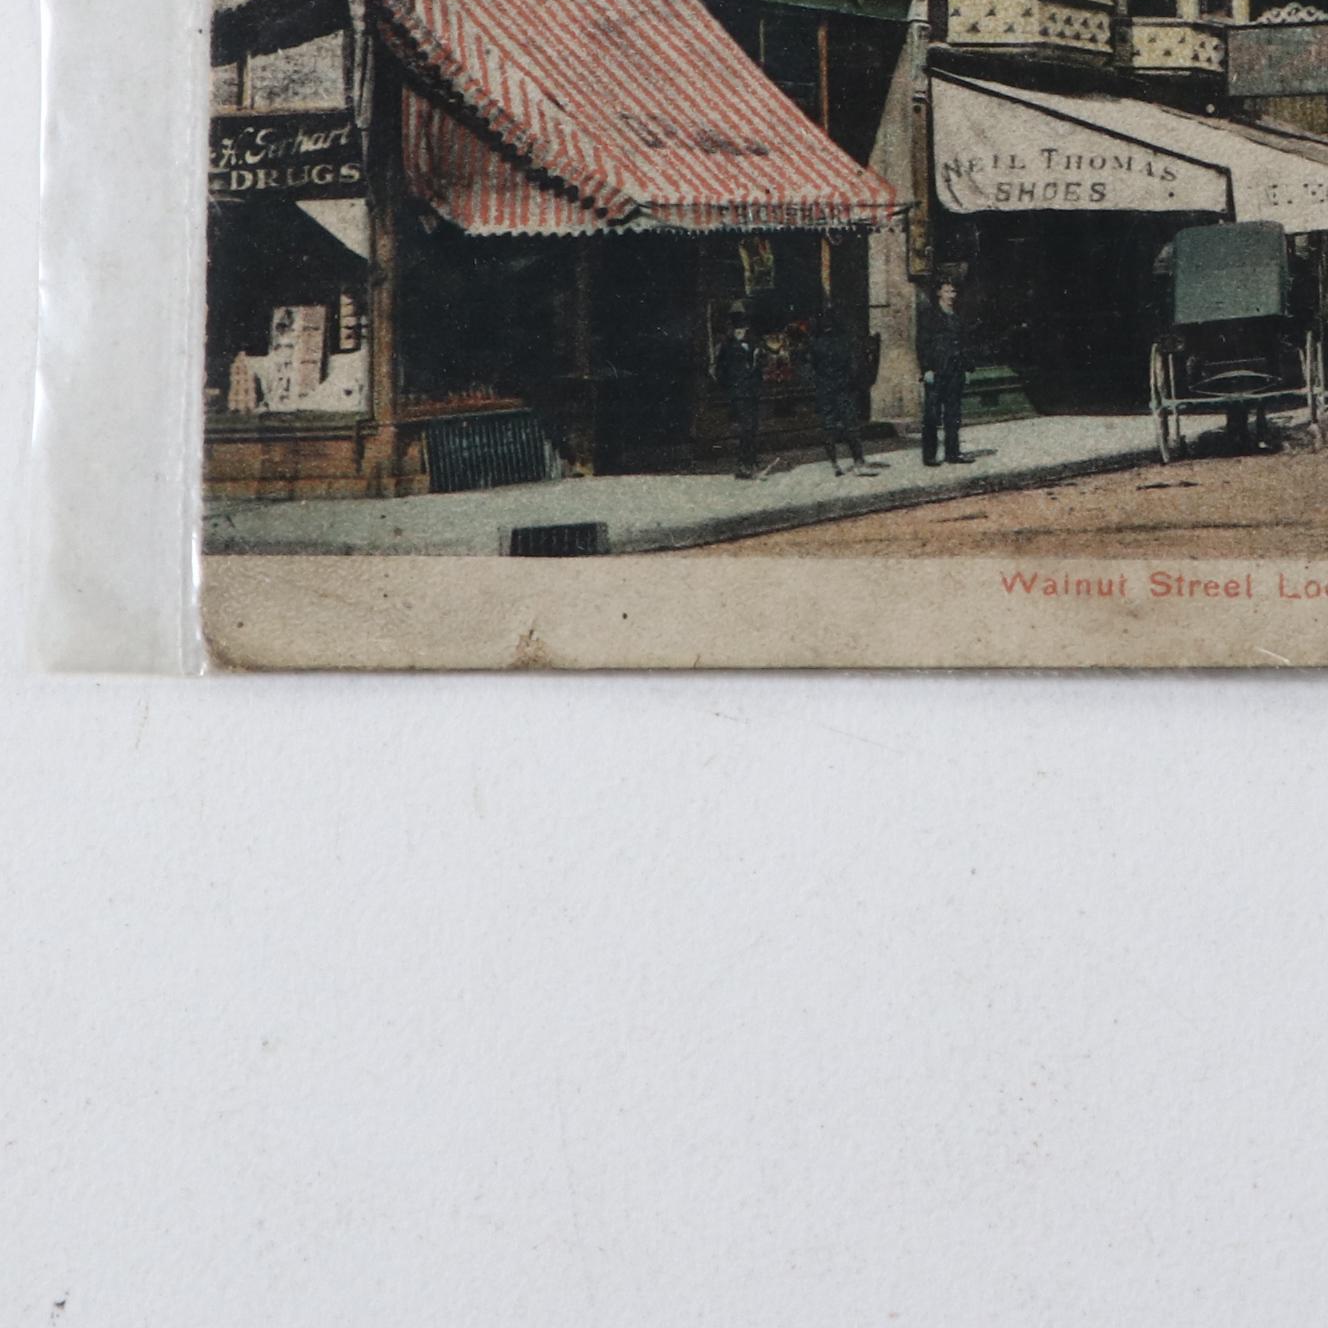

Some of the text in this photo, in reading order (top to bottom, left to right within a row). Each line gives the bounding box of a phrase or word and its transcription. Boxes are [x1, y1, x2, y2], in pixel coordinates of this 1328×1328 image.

[230, 162, 361, 191] DRUGS
[1041, 147, 1178, 183] THOMAS
[995, 181, 1108, 204] SHOES
[1001, 572, 1128, 599] Walnut
